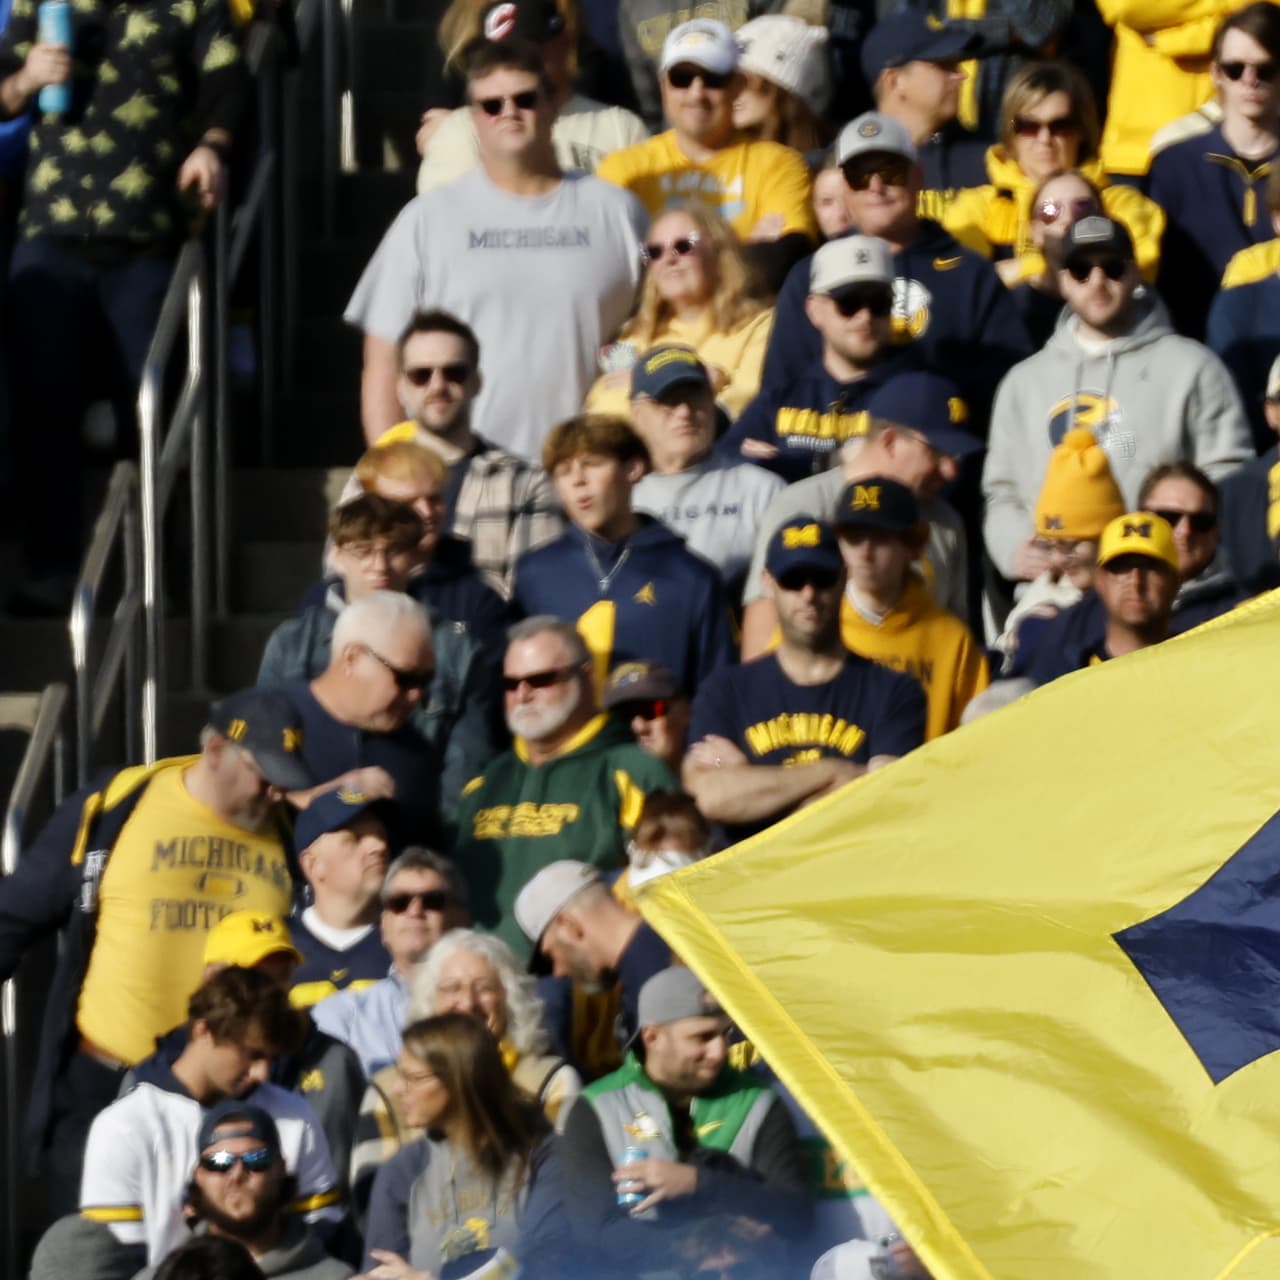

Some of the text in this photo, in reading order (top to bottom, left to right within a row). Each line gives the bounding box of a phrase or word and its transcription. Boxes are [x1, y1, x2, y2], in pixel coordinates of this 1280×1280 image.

[467, 227, 592, 250] MICHIGAN
[782, 524, 820, 548] M
[1123, 521, 1152, 540] M
[152, 838, 291, 892] MICHIGAN
